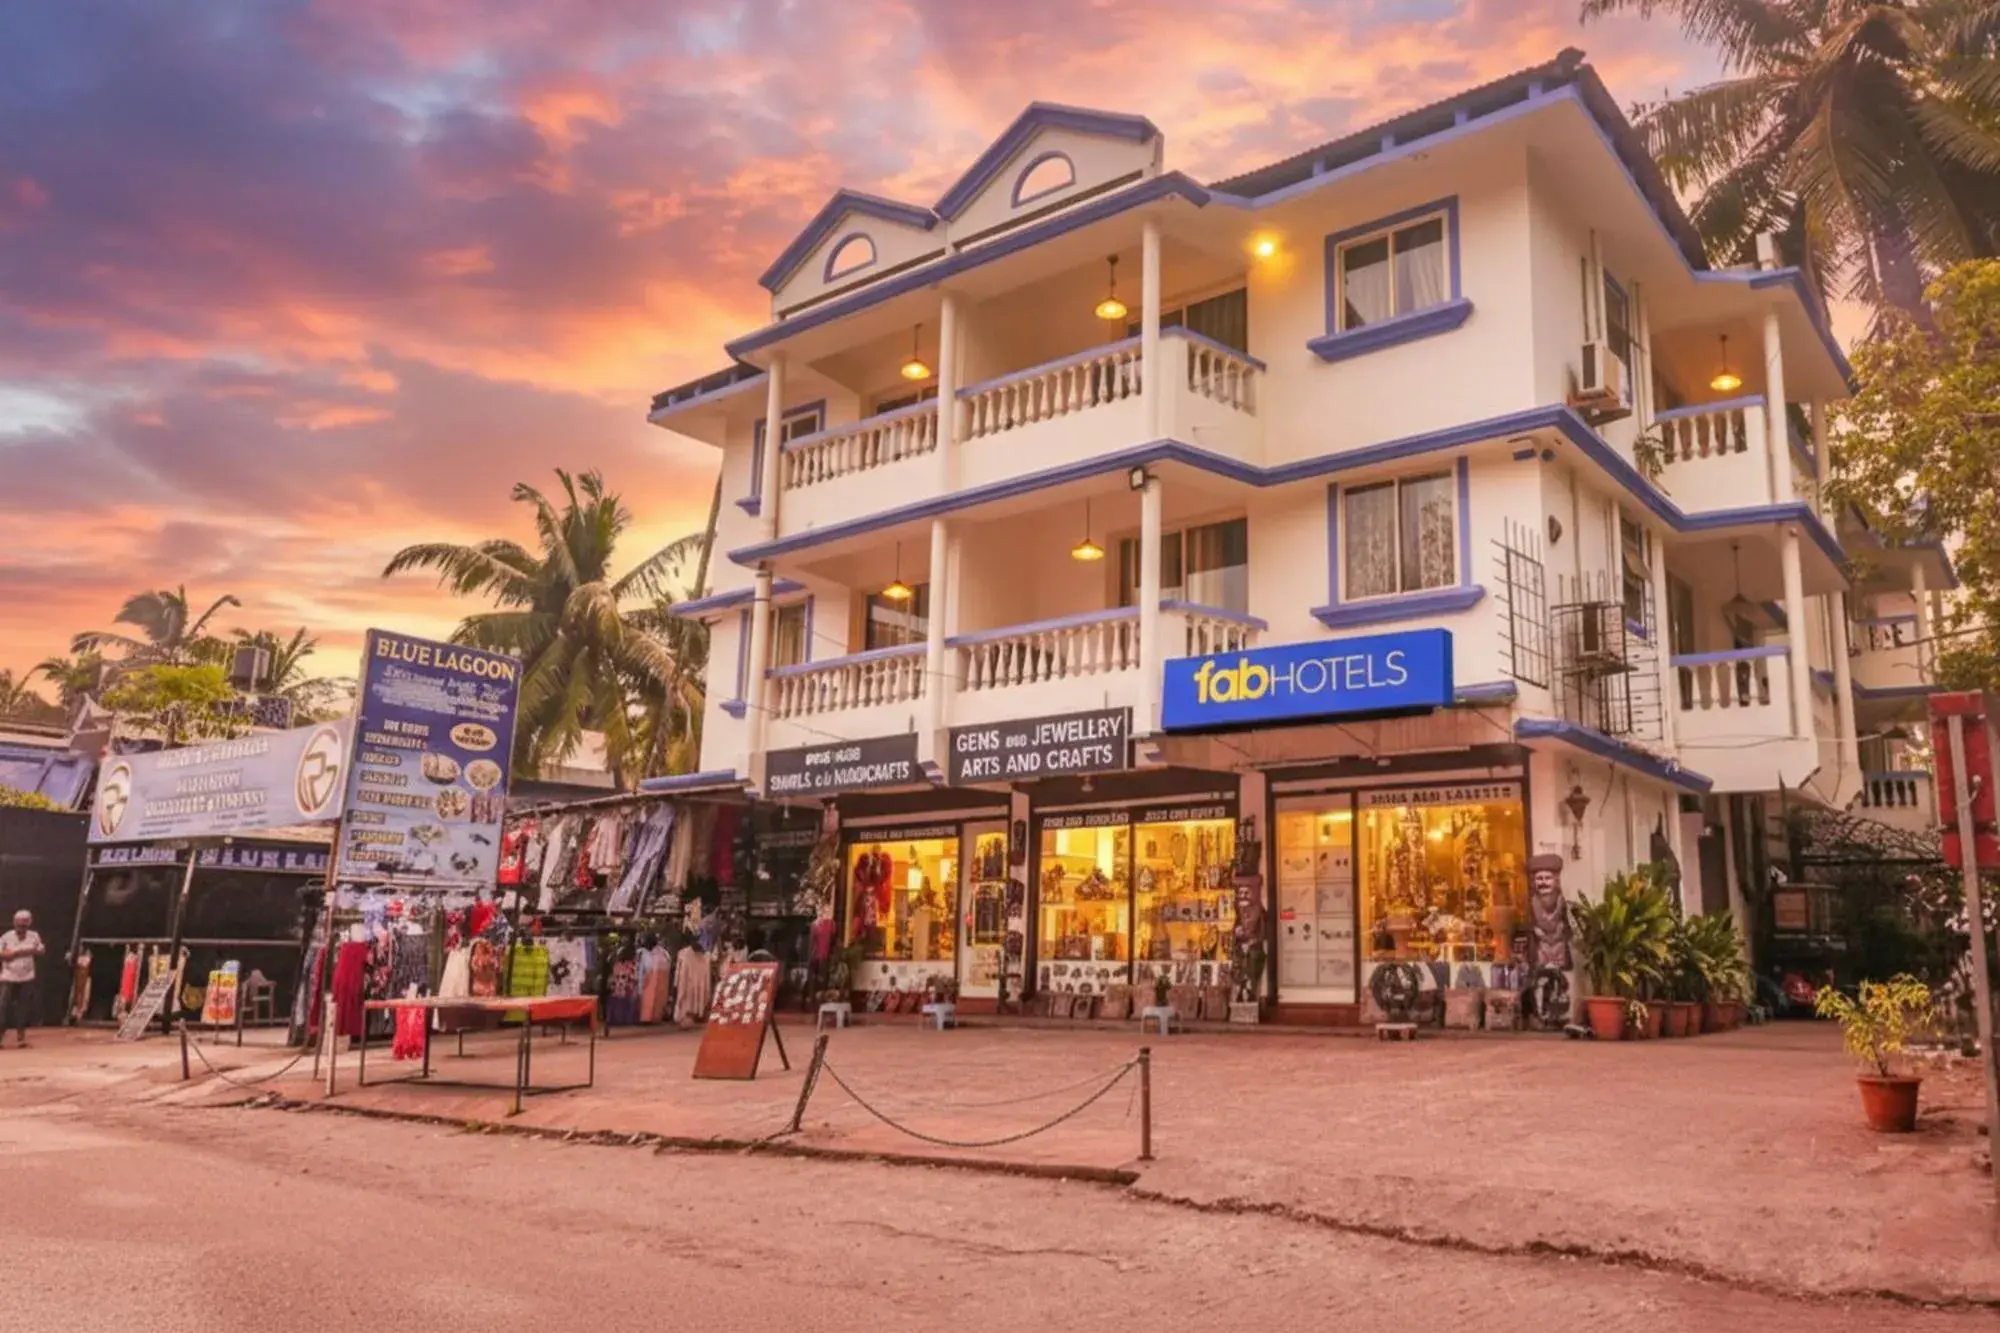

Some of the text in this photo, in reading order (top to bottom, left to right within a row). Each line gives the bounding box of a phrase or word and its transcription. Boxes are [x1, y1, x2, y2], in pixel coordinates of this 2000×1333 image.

[376, 637, 515, 682] BLUE LAGOON
[1031, 715, 1122, 747] JEWELLRY
[960, 744, 1114, 778] ARTS AND CRAFTS
